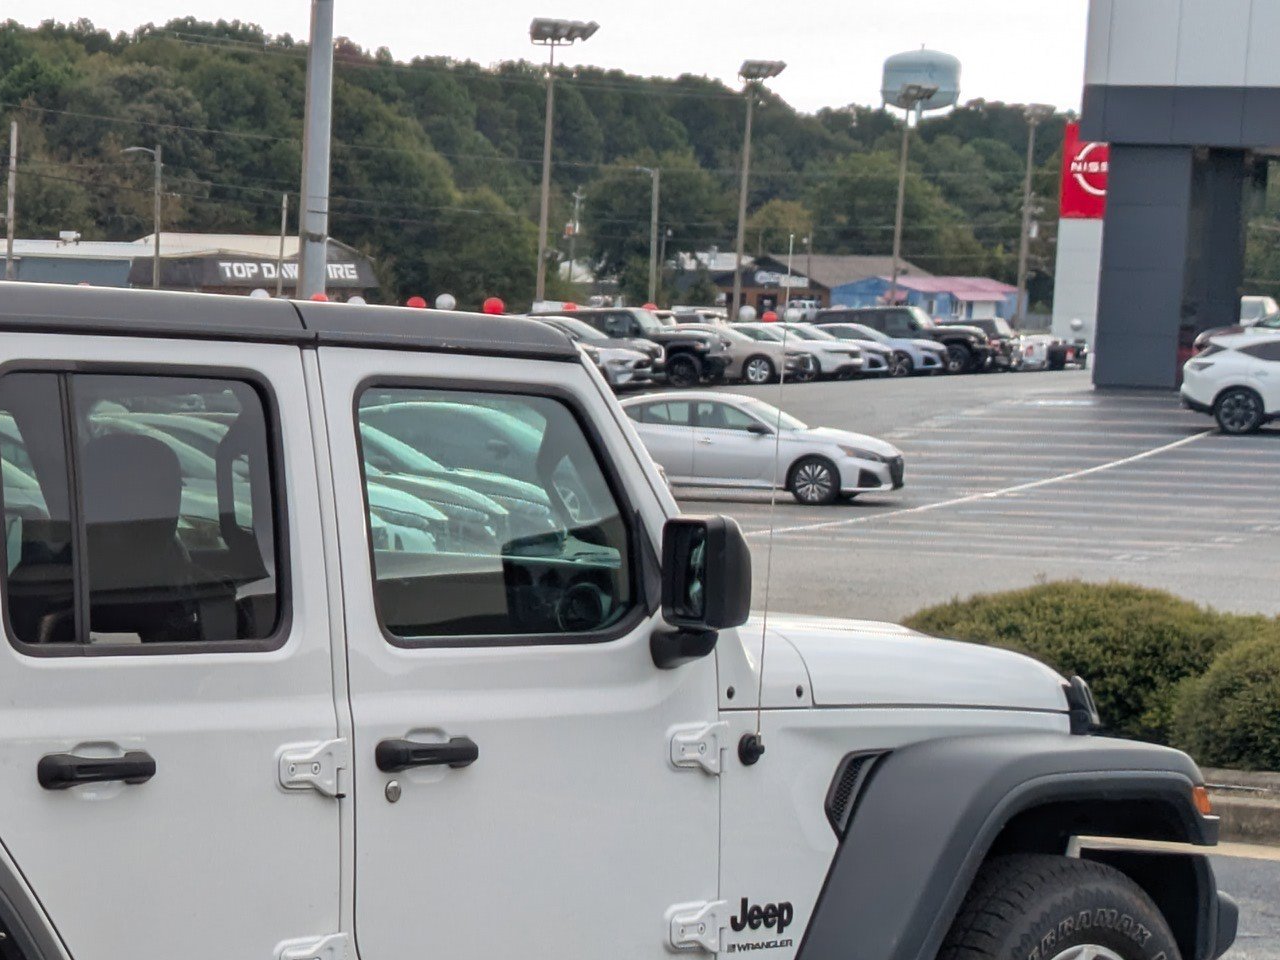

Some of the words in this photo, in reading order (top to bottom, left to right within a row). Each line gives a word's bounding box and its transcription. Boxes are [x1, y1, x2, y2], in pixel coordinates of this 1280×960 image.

[219, 262, 259, 278] TOP
[261, 262, 299, 278] DAW
[326, 263, 359, 279] IRE
[730, 897, 794, 934] Jeep
[737, 938, 793, 952] WRANGLER
